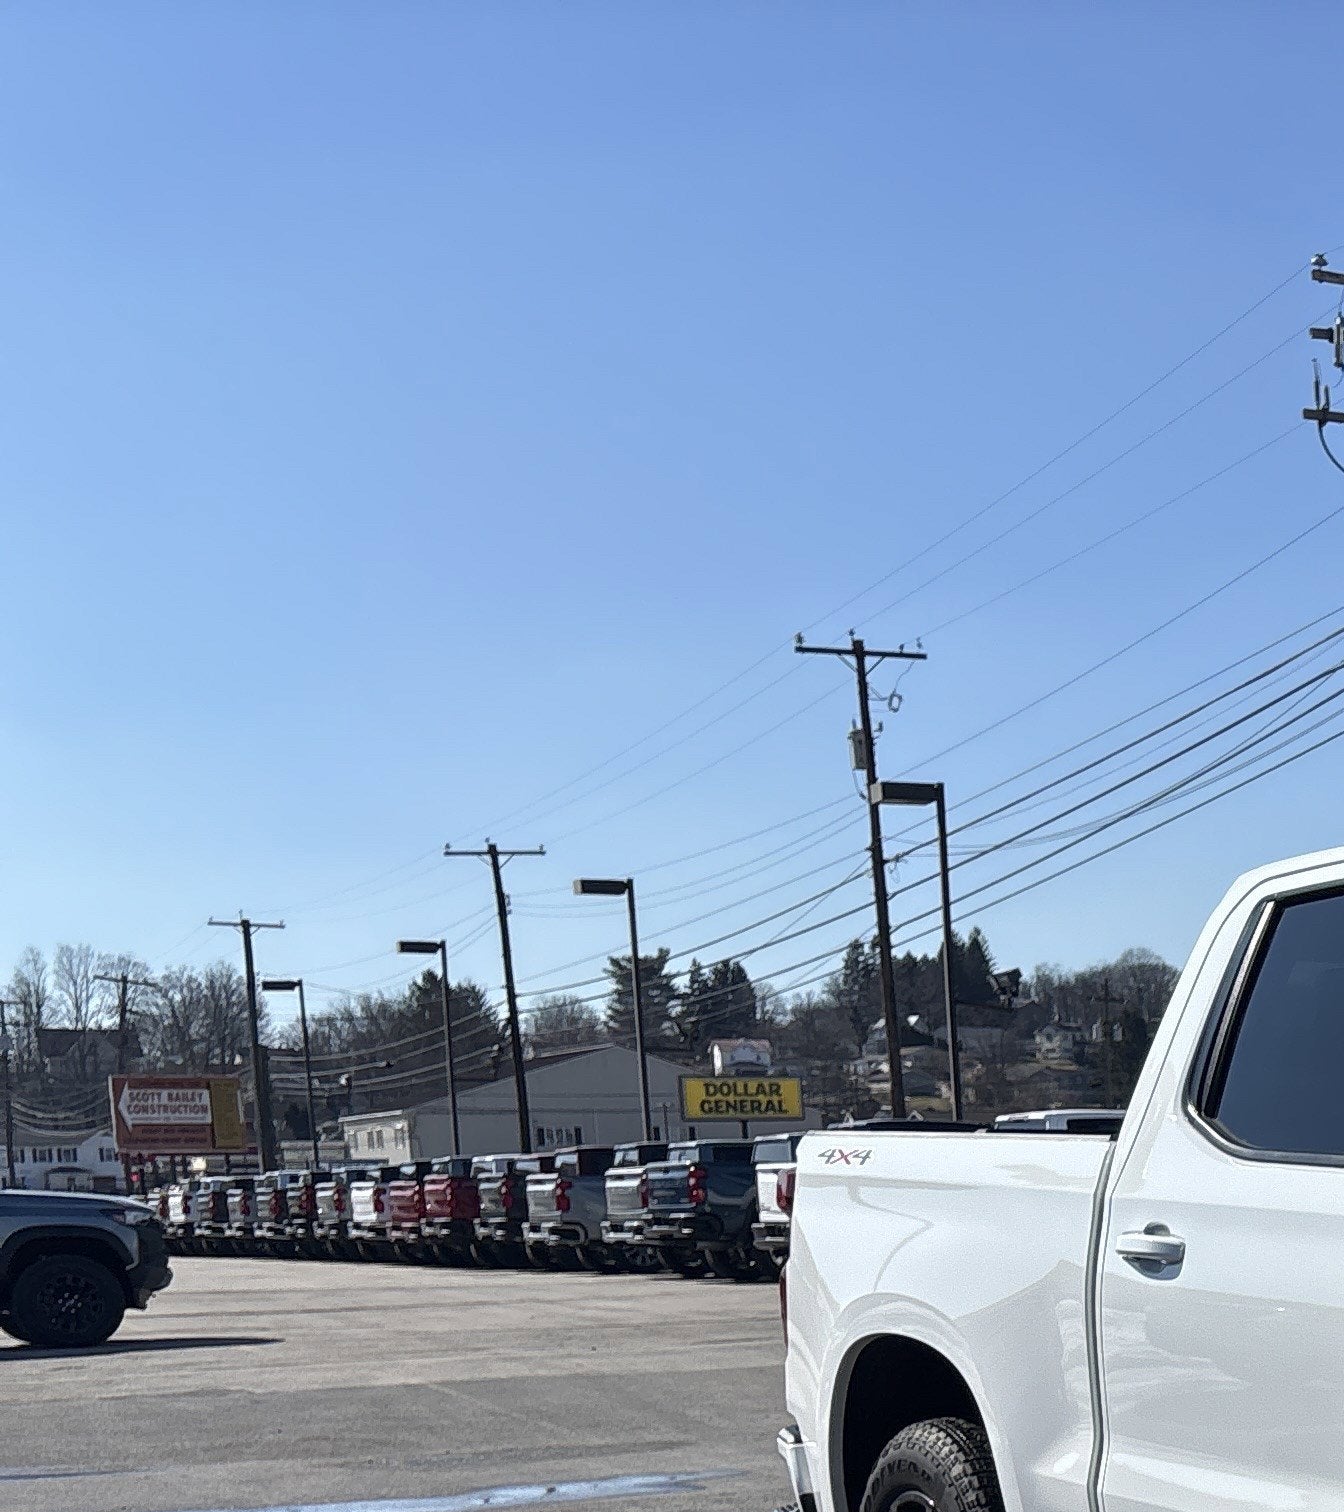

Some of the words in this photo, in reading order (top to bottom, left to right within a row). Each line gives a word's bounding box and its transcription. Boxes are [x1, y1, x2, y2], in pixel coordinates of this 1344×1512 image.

[703, 1083, 783, 1097] DOLLAR
[129, 1092, 162, 1103] SCOTT
[127, 1104, 209, 1115] CONSTRUCTION
[700, 1099, 789, 1114] GENERAL
